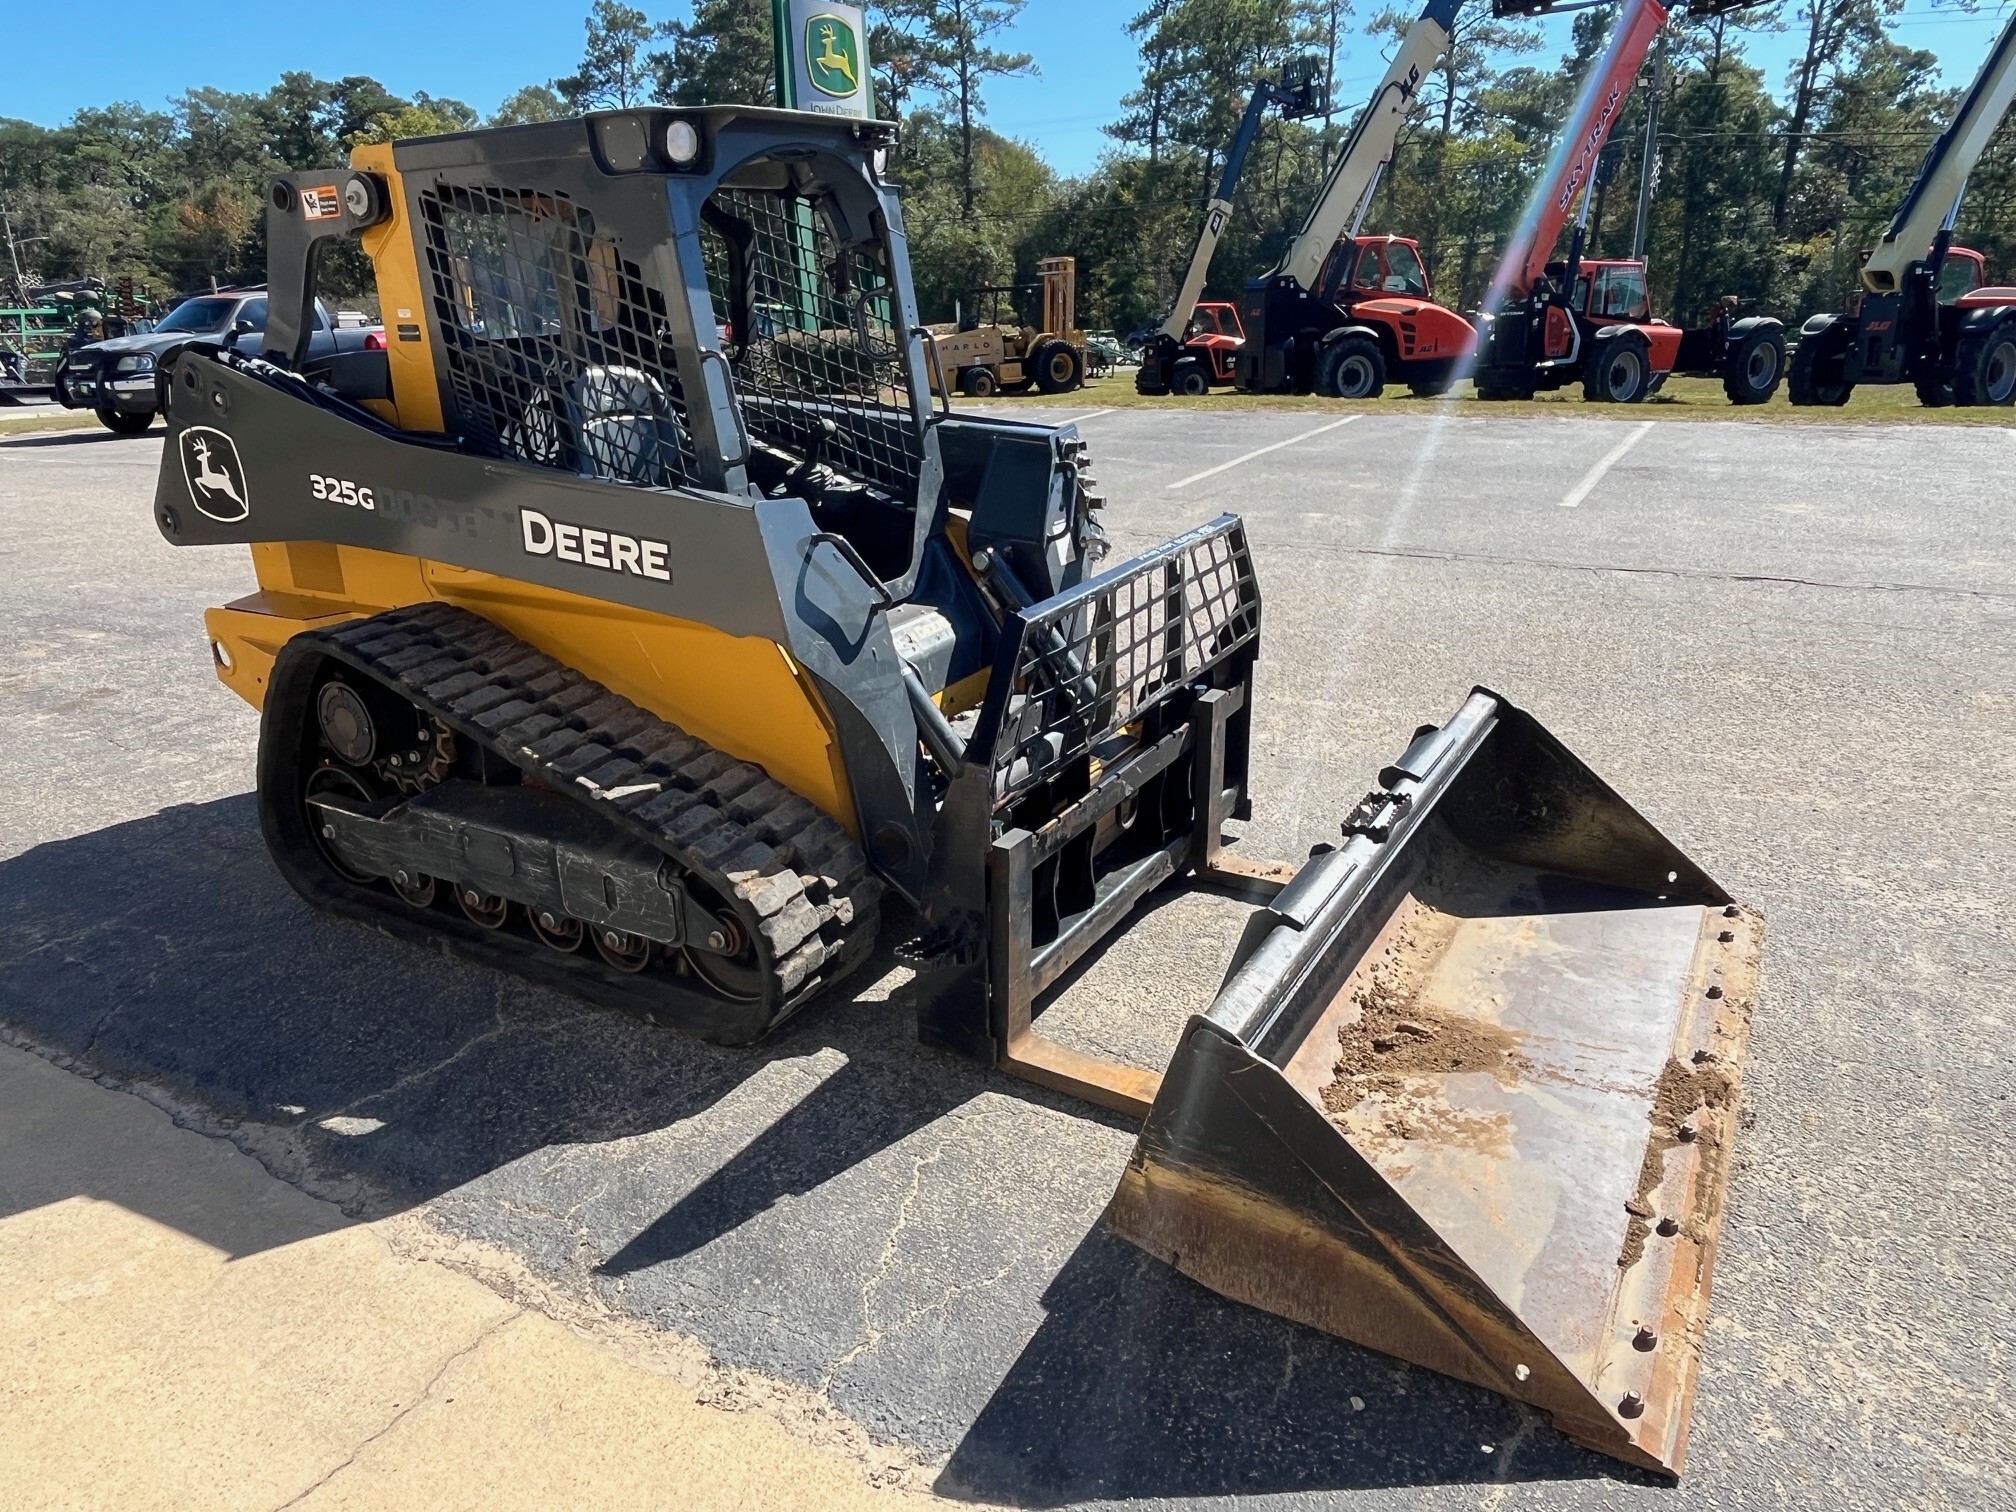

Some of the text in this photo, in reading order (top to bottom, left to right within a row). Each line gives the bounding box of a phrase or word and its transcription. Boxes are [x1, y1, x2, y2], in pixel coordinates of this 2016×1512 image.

[810, 102, 863, 118] JOHN DEERE
[1559, 81, 1621, 212] SKYTRAK
[941, 341, 990, 352] HARLO
[309, 474, 375, 510] 325G
[520, 509, 671, 581] DEERE
